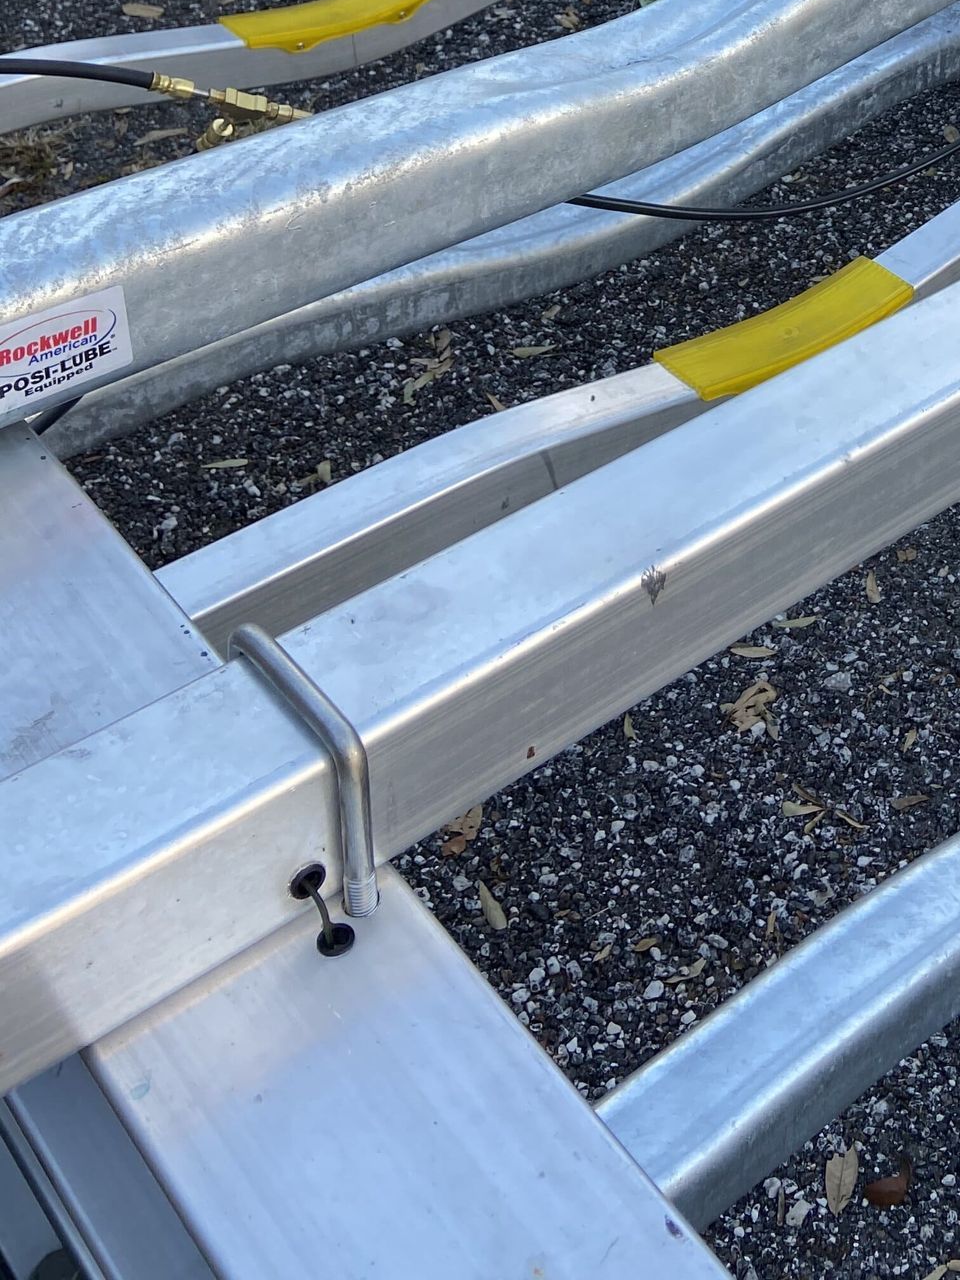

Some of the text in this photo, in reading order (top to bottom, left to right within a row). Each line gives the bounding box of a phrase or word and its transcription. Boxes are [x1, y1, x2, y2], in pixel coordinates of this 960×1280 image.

[0, 316, 97, 368] Rockwell
[28, 333, 98, 366] American
[0, 340, 112, 399] POSI-LUBE
[24, 361, 94, 397] Equipped
